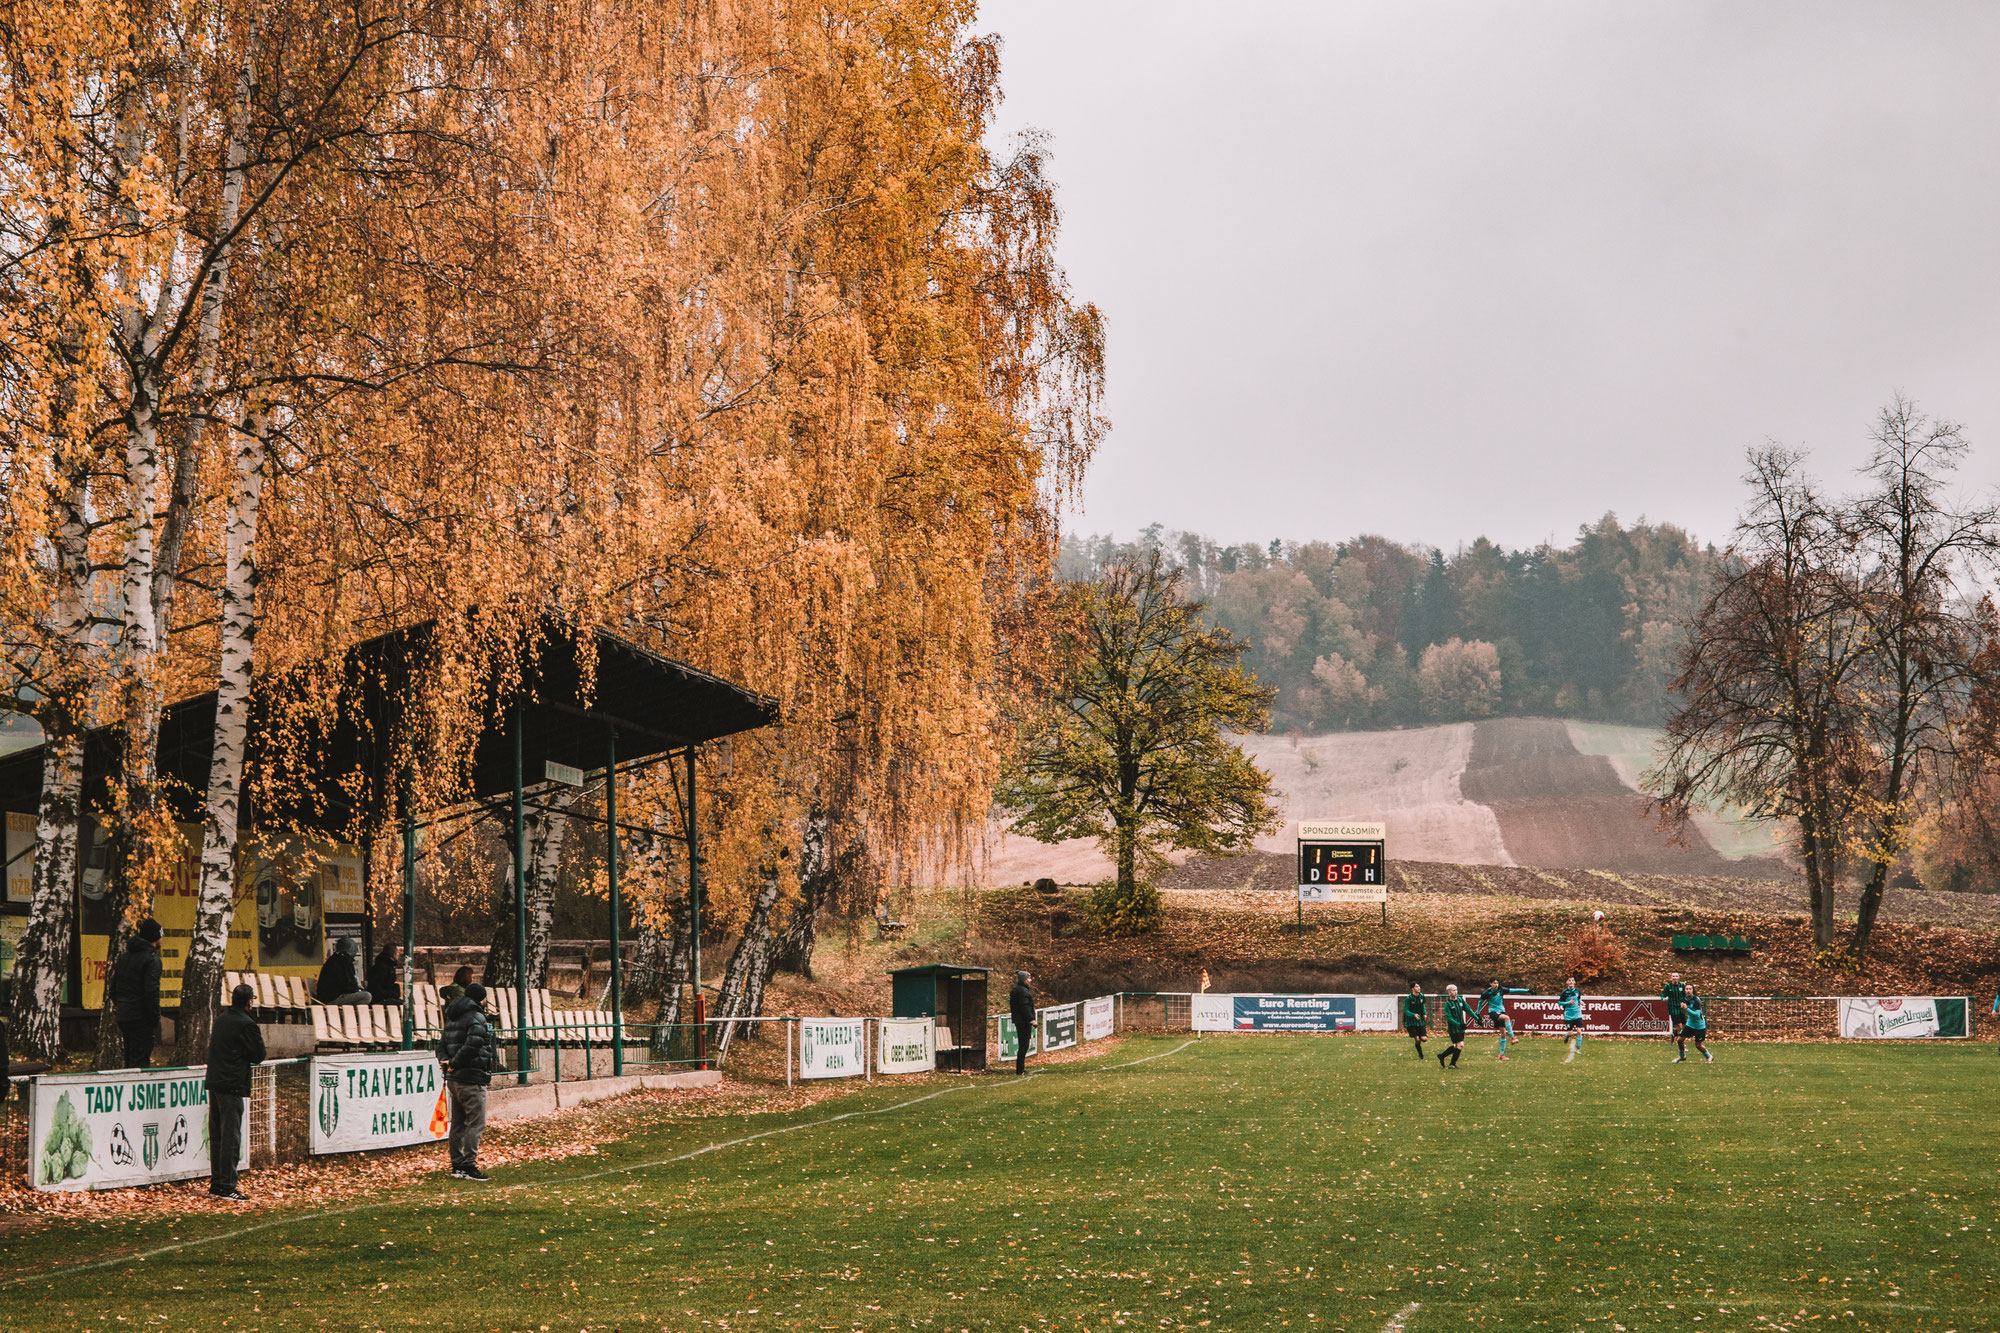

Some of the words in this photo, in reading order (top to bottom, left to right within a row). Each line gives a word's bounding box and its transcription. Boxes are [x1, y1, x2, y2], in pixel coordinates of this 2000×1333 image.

[1302, 826, 1339, 835] SPONZOR
[1340, 825, 1381, 835] ČASOMÍRY
[1316, 848, 1321, 864] 1
[1370, 848, 1376, 864] 1
[1310, 868, 1320, 882] D
[1365, 868, 1375, 882] H
[1258, 998, 1285, 1009] Euro
[1287, 999, 1330, 1010] Renting
[1588, 1001, 1622, 1011] PRÁCE
[1627, 1017, 1669, 1031] střechy
[816, 1026, 853, 1046] TRAVERZA
[346, 1064, 435, 1099] TRAVERZA
[85, 1085, 124, 1114] TADY
[128, 1083, 166, 1112] JSME
[170, 1079, 208, 1110] DOMA
[371, 1106, 414, 1135] ARÉNA
